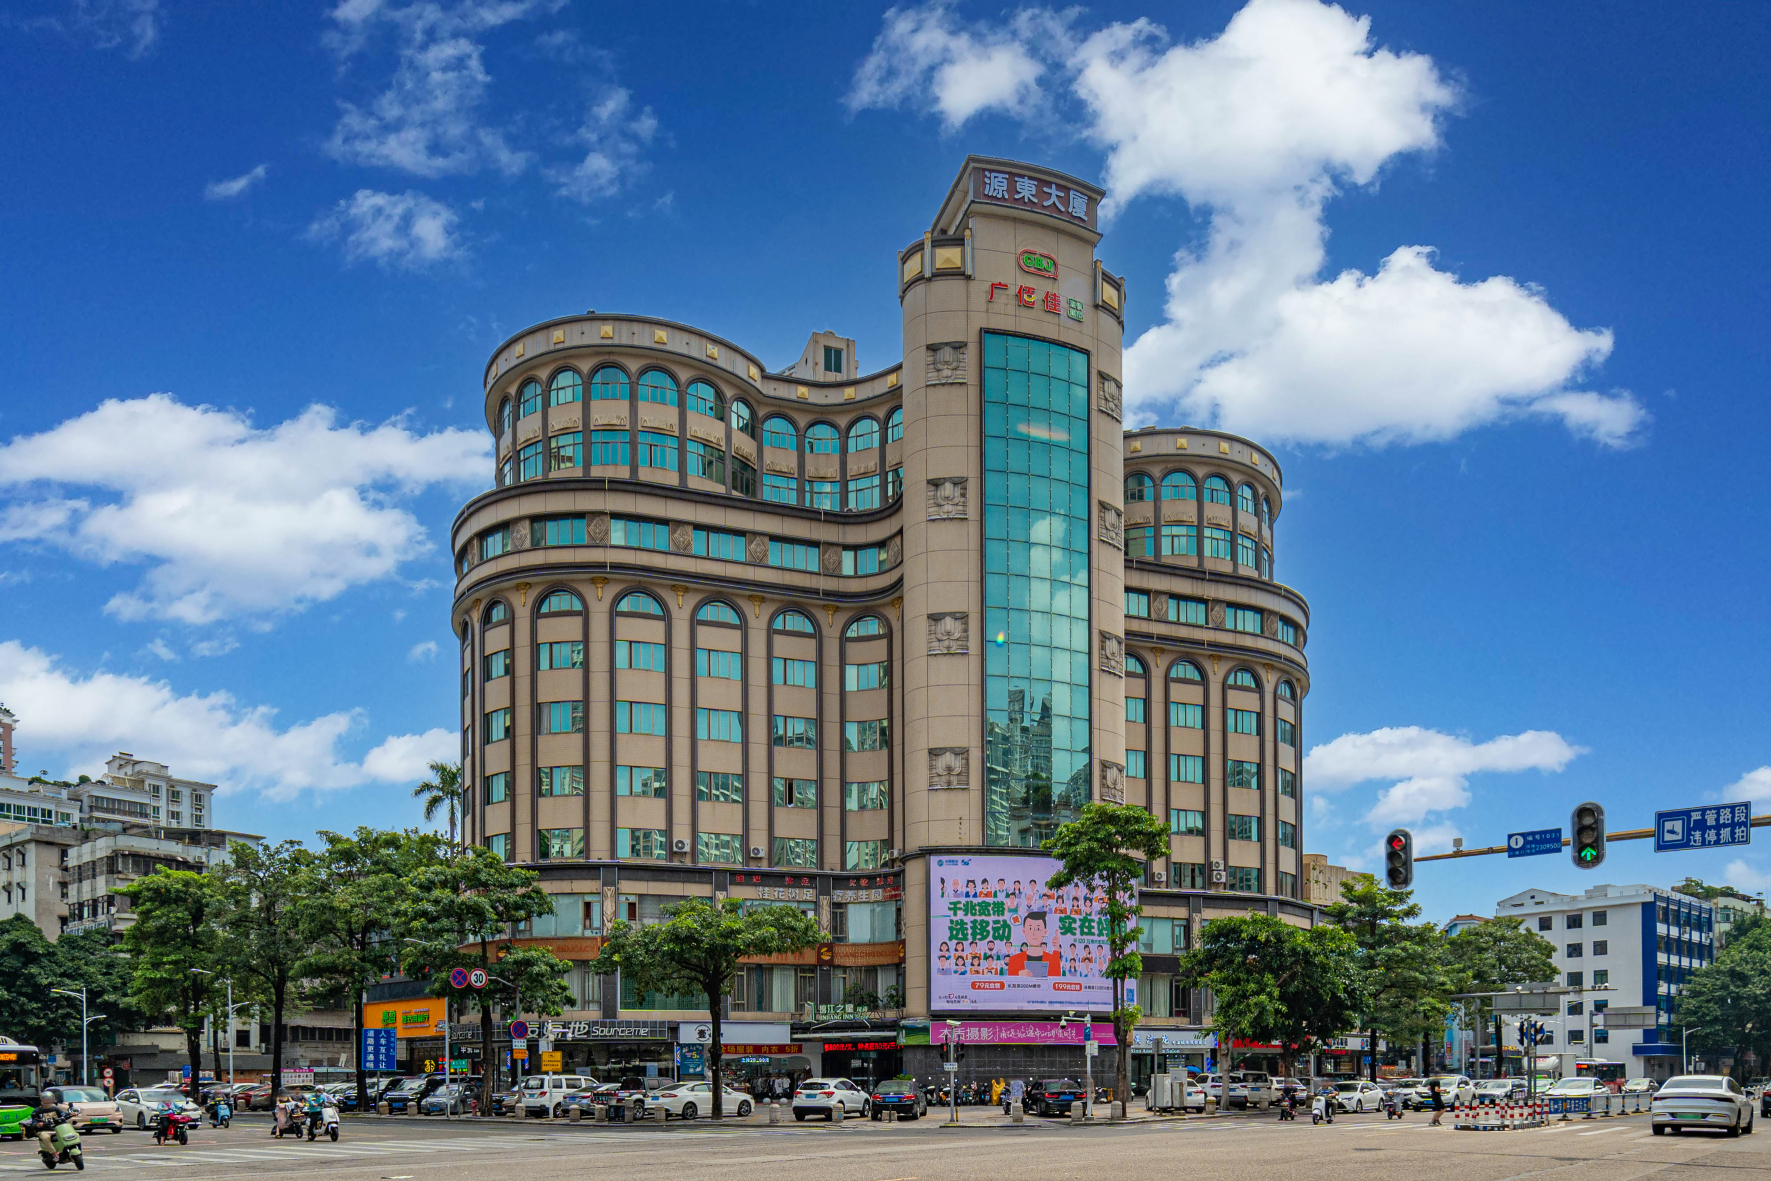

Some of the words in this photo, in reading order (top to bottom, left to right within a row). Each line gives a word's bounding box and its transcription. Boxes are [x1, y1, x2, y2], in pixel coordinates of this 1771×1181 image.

[1023, 254, 1054, 271] GBJ
[1690, 806, 1747, 828] 严管路段
[1690, 826, 1747, 846] 违停抓拍
[948, 900, 1006, 917] 千兆宽带
[948, 918, 1012, 942] 选移动
[473, 973, 484, 984] 30
[379, 1029, 387, 1069] 人车互礼让
[785, 1045, 799, 1054] 5折
